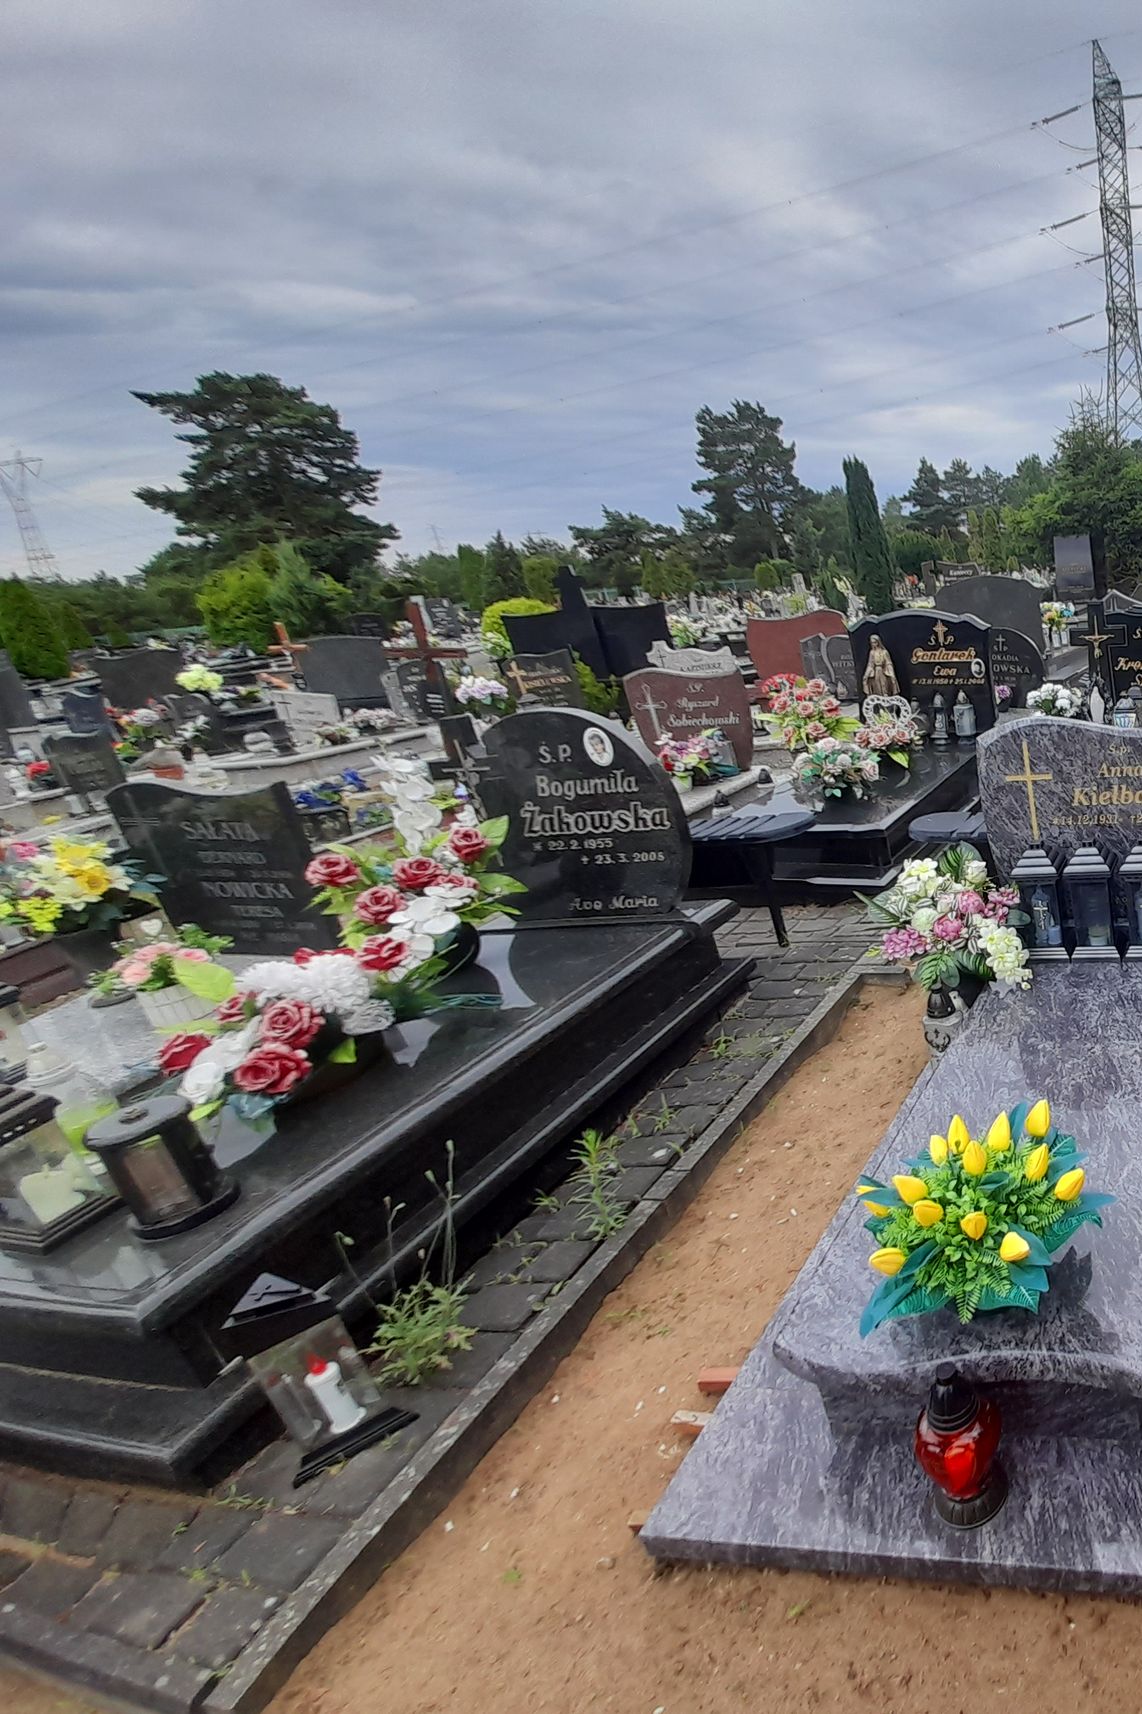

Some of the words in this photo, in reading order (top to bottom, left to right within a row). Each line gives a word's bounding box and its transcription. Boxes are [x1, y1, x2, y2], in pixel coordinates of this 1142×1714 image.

[933, 665, 957, 676] Ewa
[675, 696, 720, 711] Ryszard
[520, 801, 672, 837] Żakowska
[200, 881, 295, 899] NOWICKA
[608, 895, 659, 910] Maria
